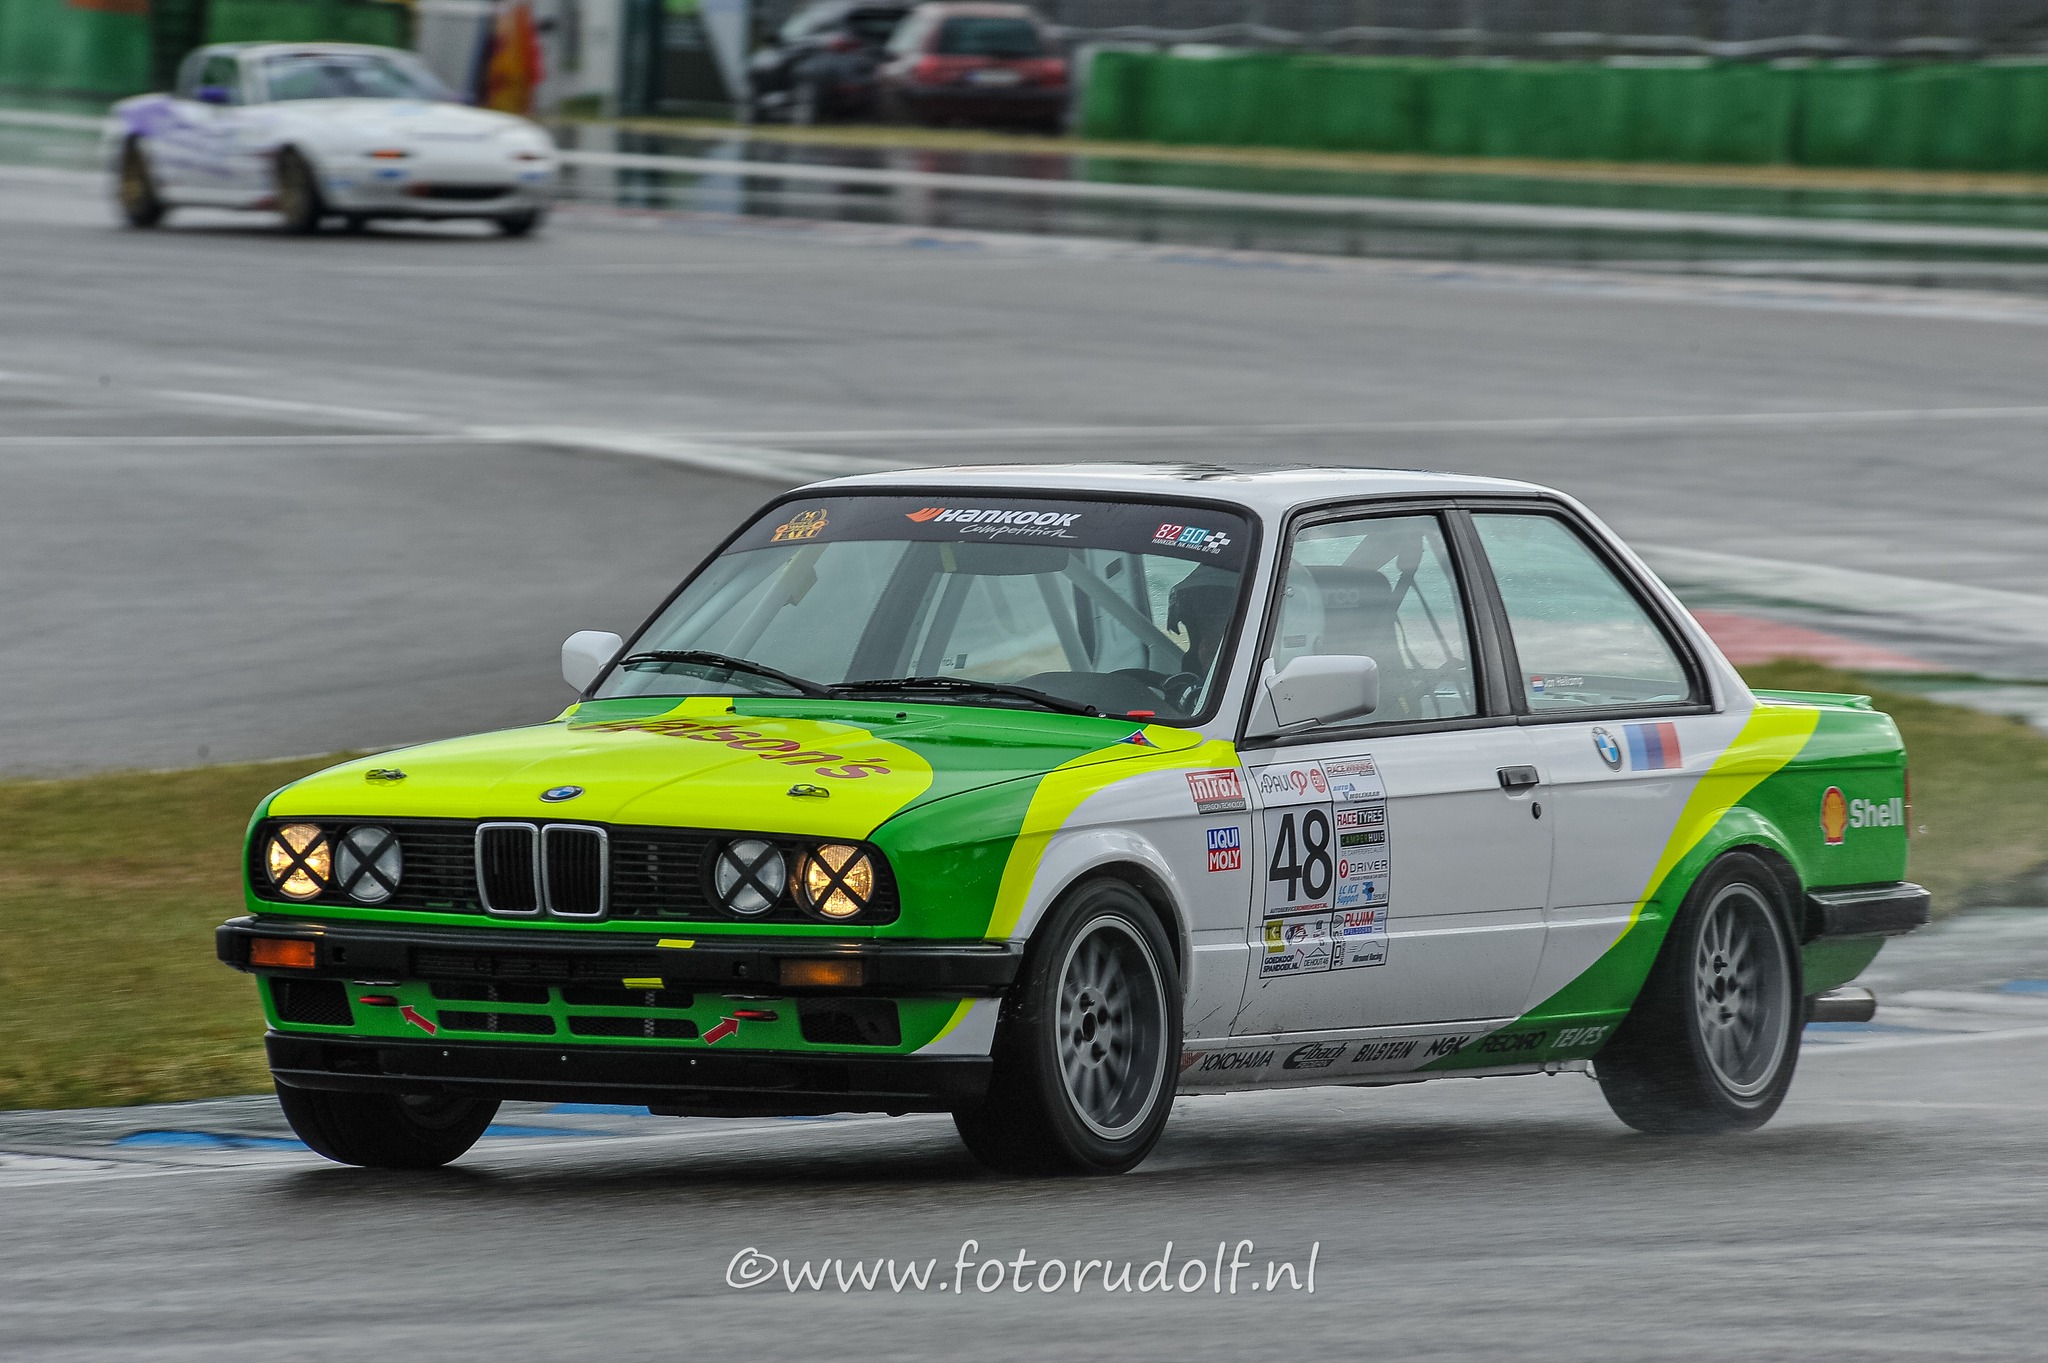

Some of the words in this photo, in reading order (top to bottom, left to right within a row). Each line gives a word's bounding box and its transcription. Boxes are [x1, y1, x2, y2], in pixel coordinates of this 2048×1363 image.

[1155, 524, 1182, 539] 82
[1180, 528, 1206, 543] 90
[1849, 797, 1904, 828] Shell
[1208, 828, 1239, 849] LIQUI
[1209, 849, 1241, 871] MOLY
[1269, 808, 1334, 902] 48
[1350, 860, 1388, 873] DRIVER
[1344, 911, 1374, 927] PLUIM
[1423, 1035, 1470, 1057] NGK
[1477, 1030, 1547, 1053] RECARO
[1551, 1025, 1609, 1048] TEVES
[1199, 1050, 1275, 1072] YOKOHAMA
[1352, 1040, 1418, 1063] BILSTEIN
